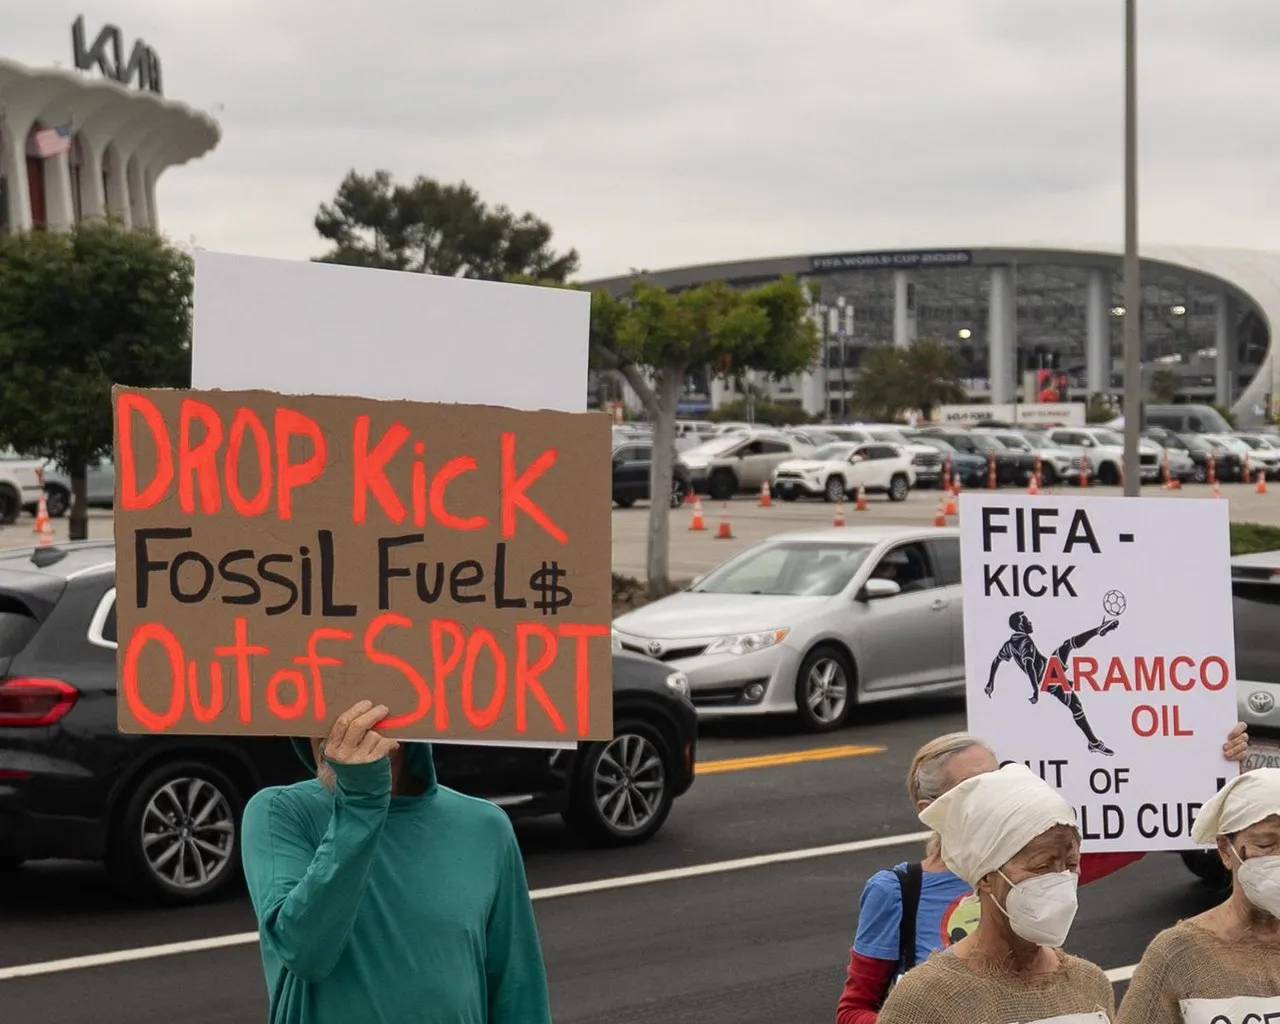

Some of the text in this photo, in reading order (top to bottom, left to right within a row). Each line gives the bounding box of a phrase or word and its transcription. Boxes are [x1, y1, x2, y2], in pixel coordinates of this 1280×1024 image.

[117, 393, 328, 521] DROP
[982, 507, 1102, 553] FIFA
[983, 564, 1079, 598] KICK
[266, 627, 354, 721] of
[363, 612, 611, 737] SPORT
[1040, 656, 1230, 692] ARAMCO
[1131, 704, 1194, 737] OIL
[1089, 768, 1130, 794] OF
